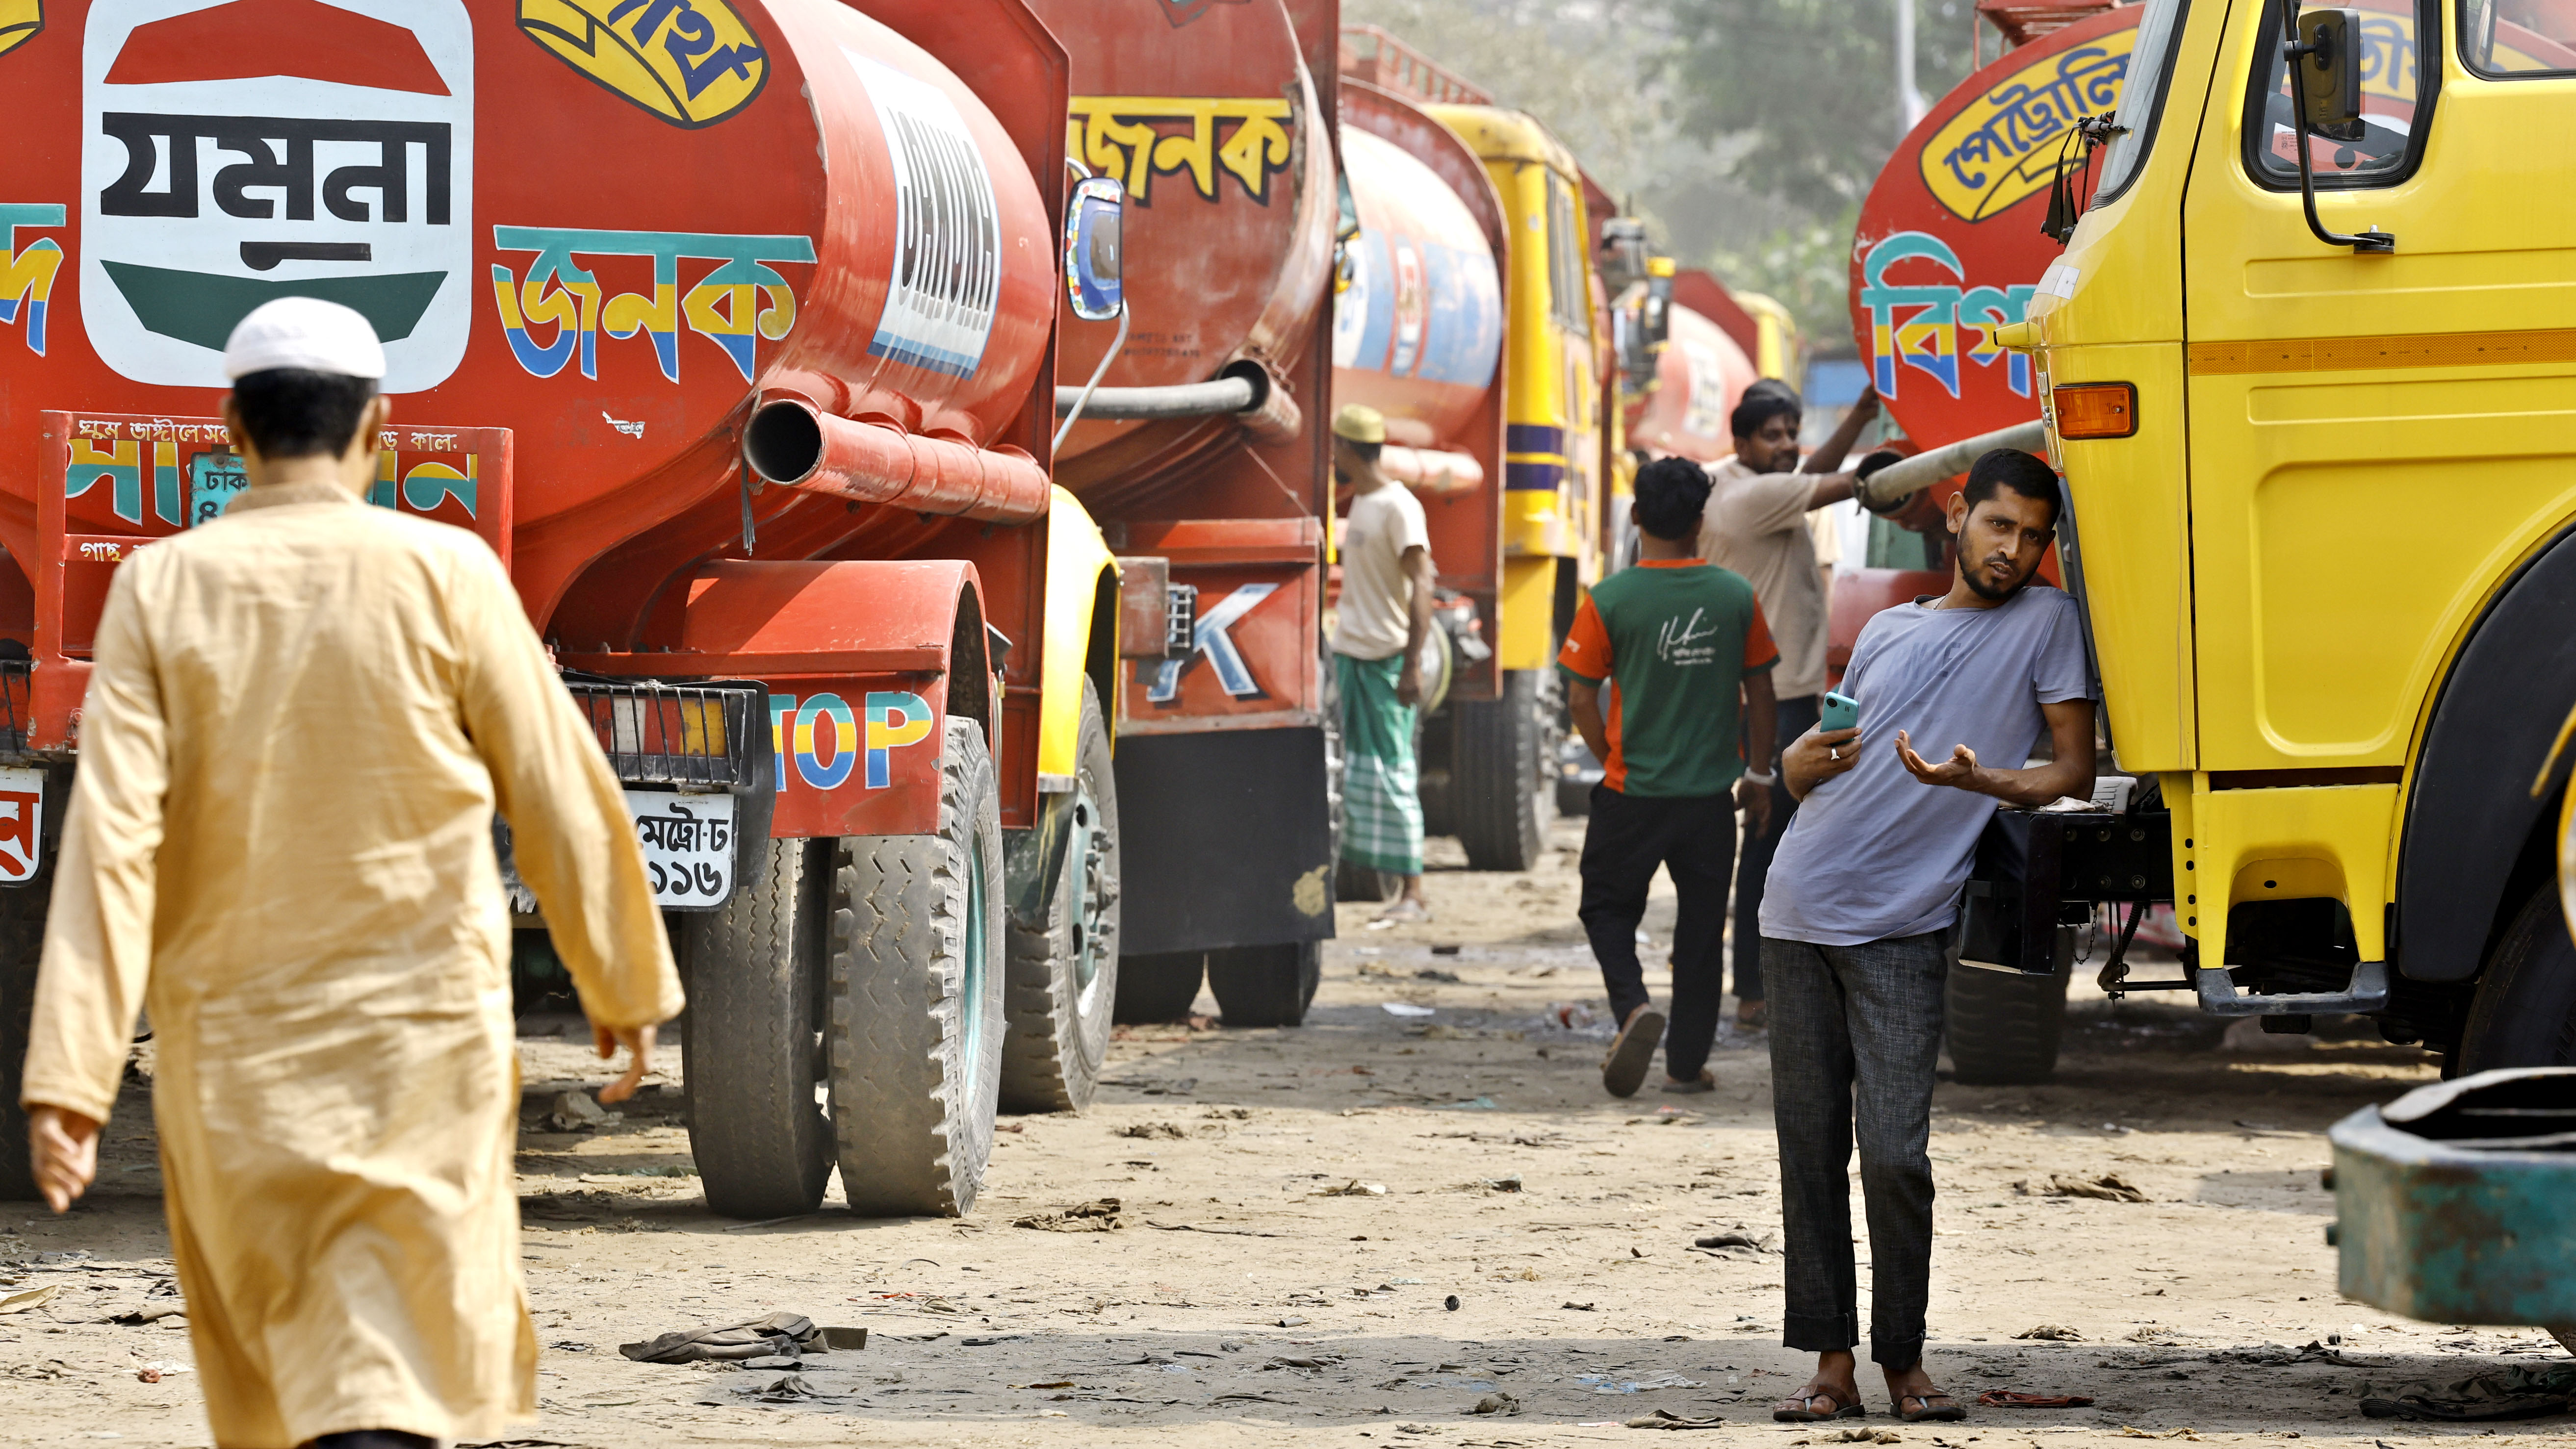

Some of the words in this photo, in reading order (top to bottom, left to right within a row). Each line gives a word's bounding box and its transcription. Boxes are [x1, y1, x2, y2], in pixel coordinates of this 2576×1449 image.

[101, 112, 451, 271] যমুনা
[491, 225, 818, 384] জনক
[1860, 230, 2037, 400] বিপ
[78, 419, 122, 440] ঘুম
[769, 691, 933, 790] TOP
